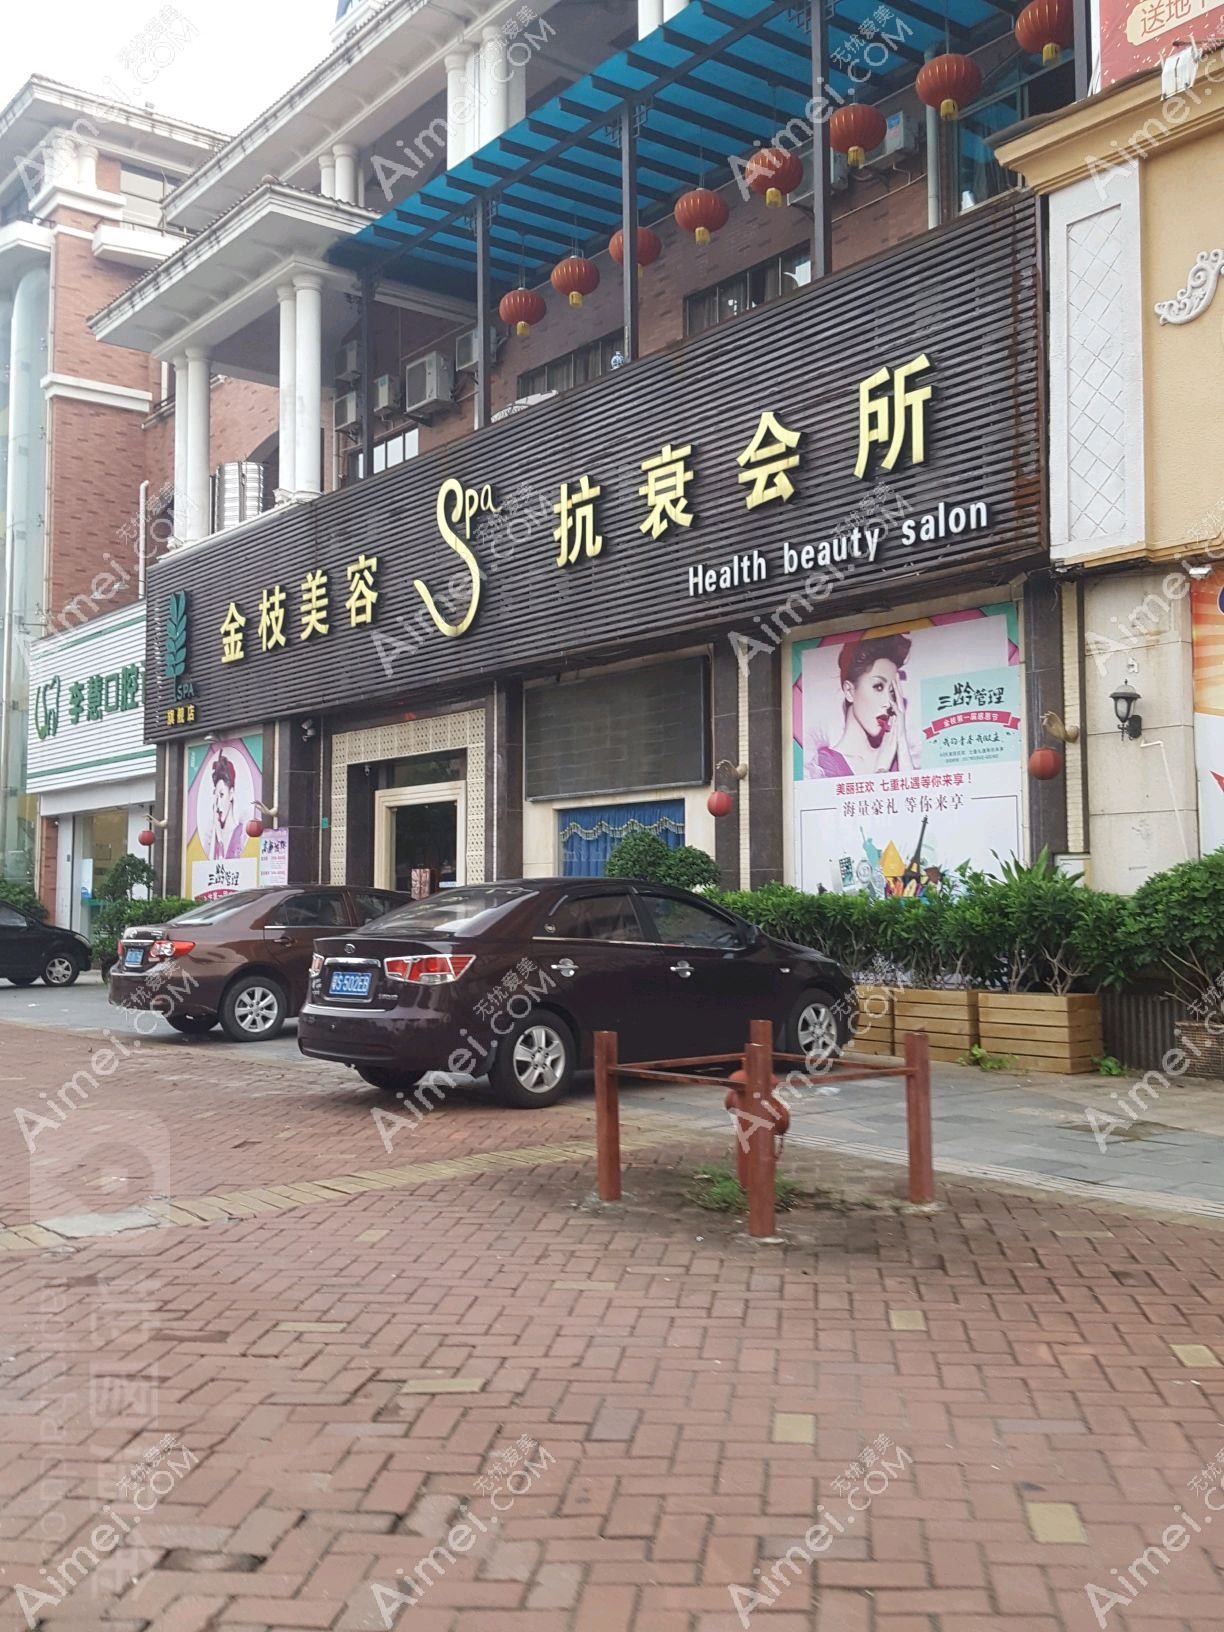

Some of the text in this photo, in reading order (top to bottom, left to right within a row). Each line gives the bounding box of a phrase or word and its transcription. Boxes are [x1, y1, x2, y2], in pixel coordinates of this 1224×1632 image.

[1141, 0, 1205, 37] 送地
[220, 353, 935, 664] 金枝美容 Spa 抗衰会所
[687, 500, 989, 597] Health beauty salon
[69, 660, 145, 725] 李慧口腔
[177, 683, 195, 700] SPA
[937, 681, 1005, 710] 三龄管理
[836, 780, 875, 796] 美丽狂欢
